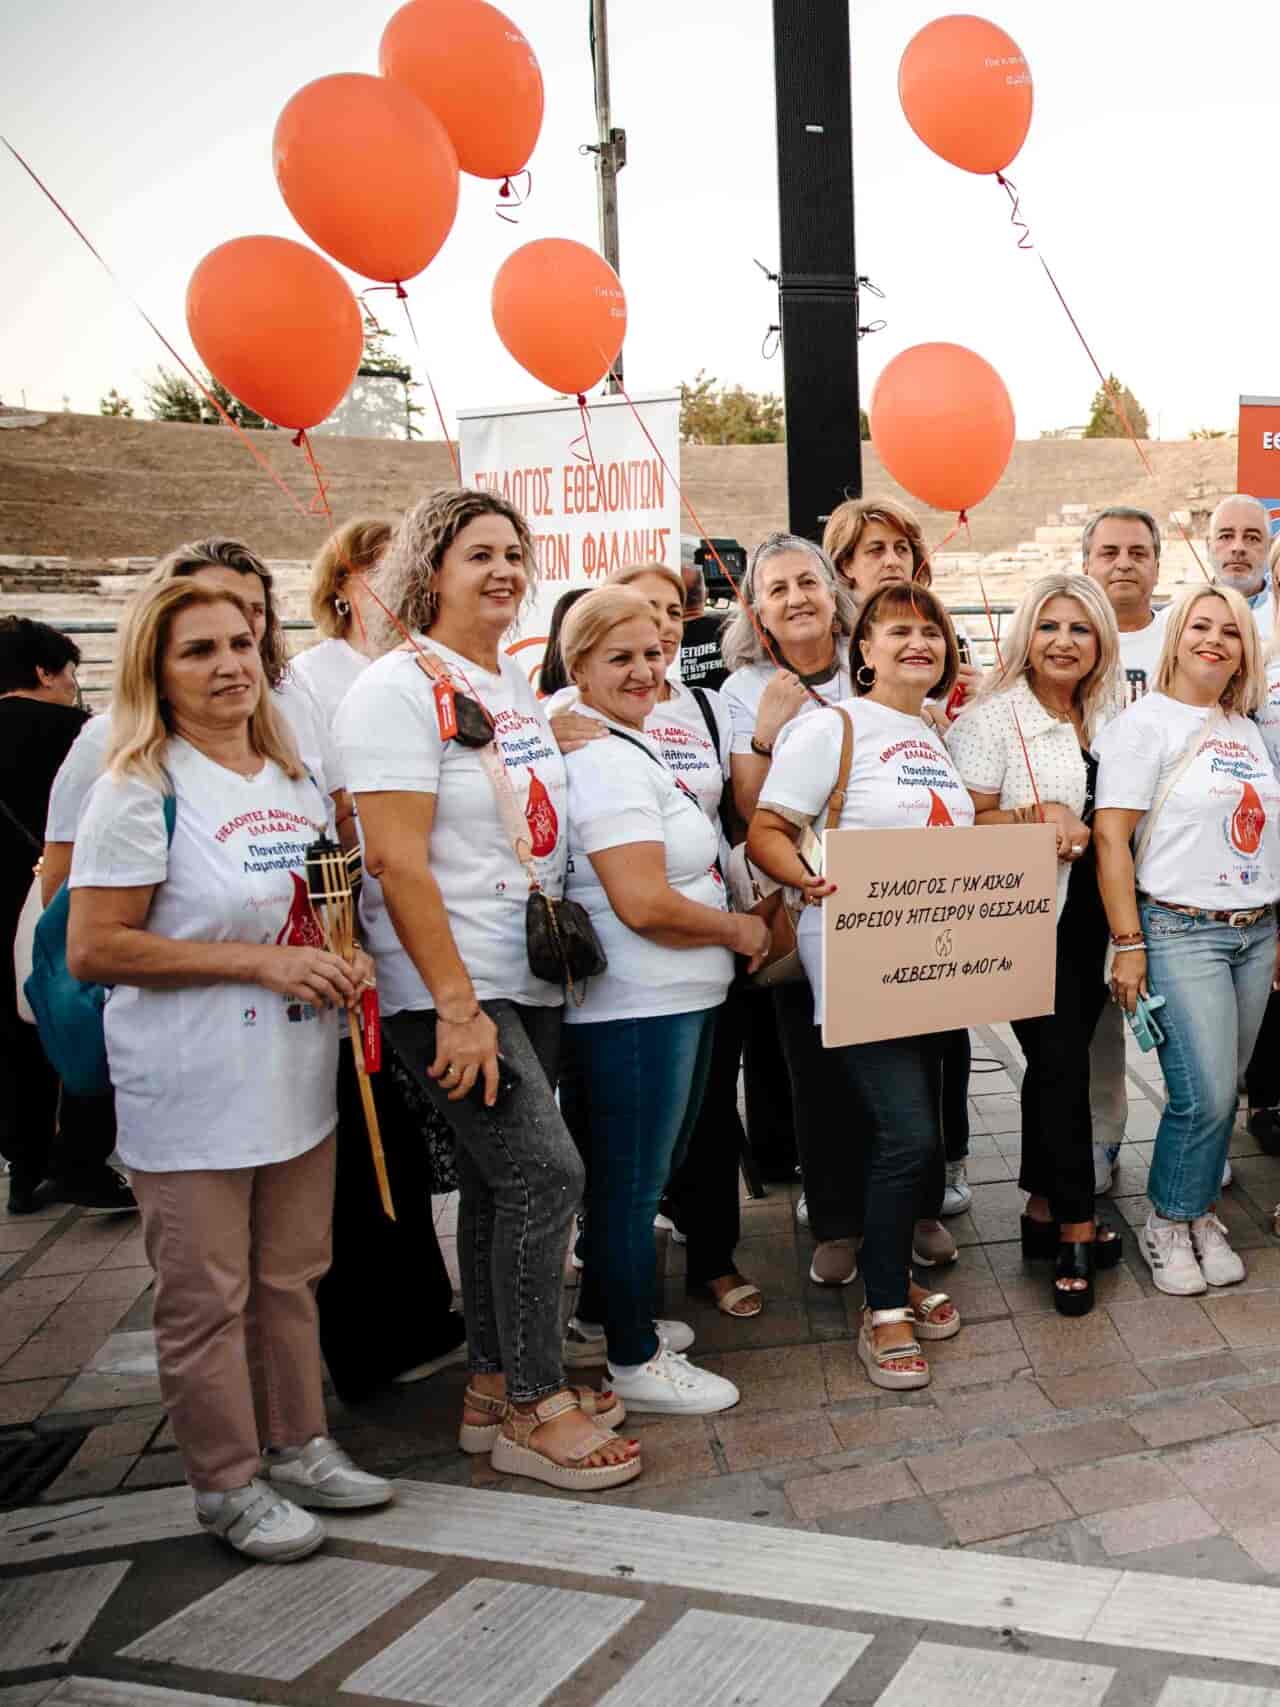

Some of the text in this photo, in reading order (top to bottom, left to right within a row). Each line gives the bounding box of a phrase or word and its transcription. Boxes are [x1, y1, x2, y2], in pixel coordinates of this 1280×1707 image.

[563, 459, 664, 514] ΕΘΕΛΟΝΤΩΝ
[867, 872, 1024, 898] ΣΥΛΛΟΓΟΣ ΓΥΝΑΙΚΩΝ
[835, 898, 1051, 930] ΒΟΡΕΙΟΥ ΗΠΕΙΡΟΥ ΘΕΣΣΑΛΙΑΣ
[882, 957, 1013, 984] «ΑΣΒΕΣΤΗ ΦΛΟΓΑ»
